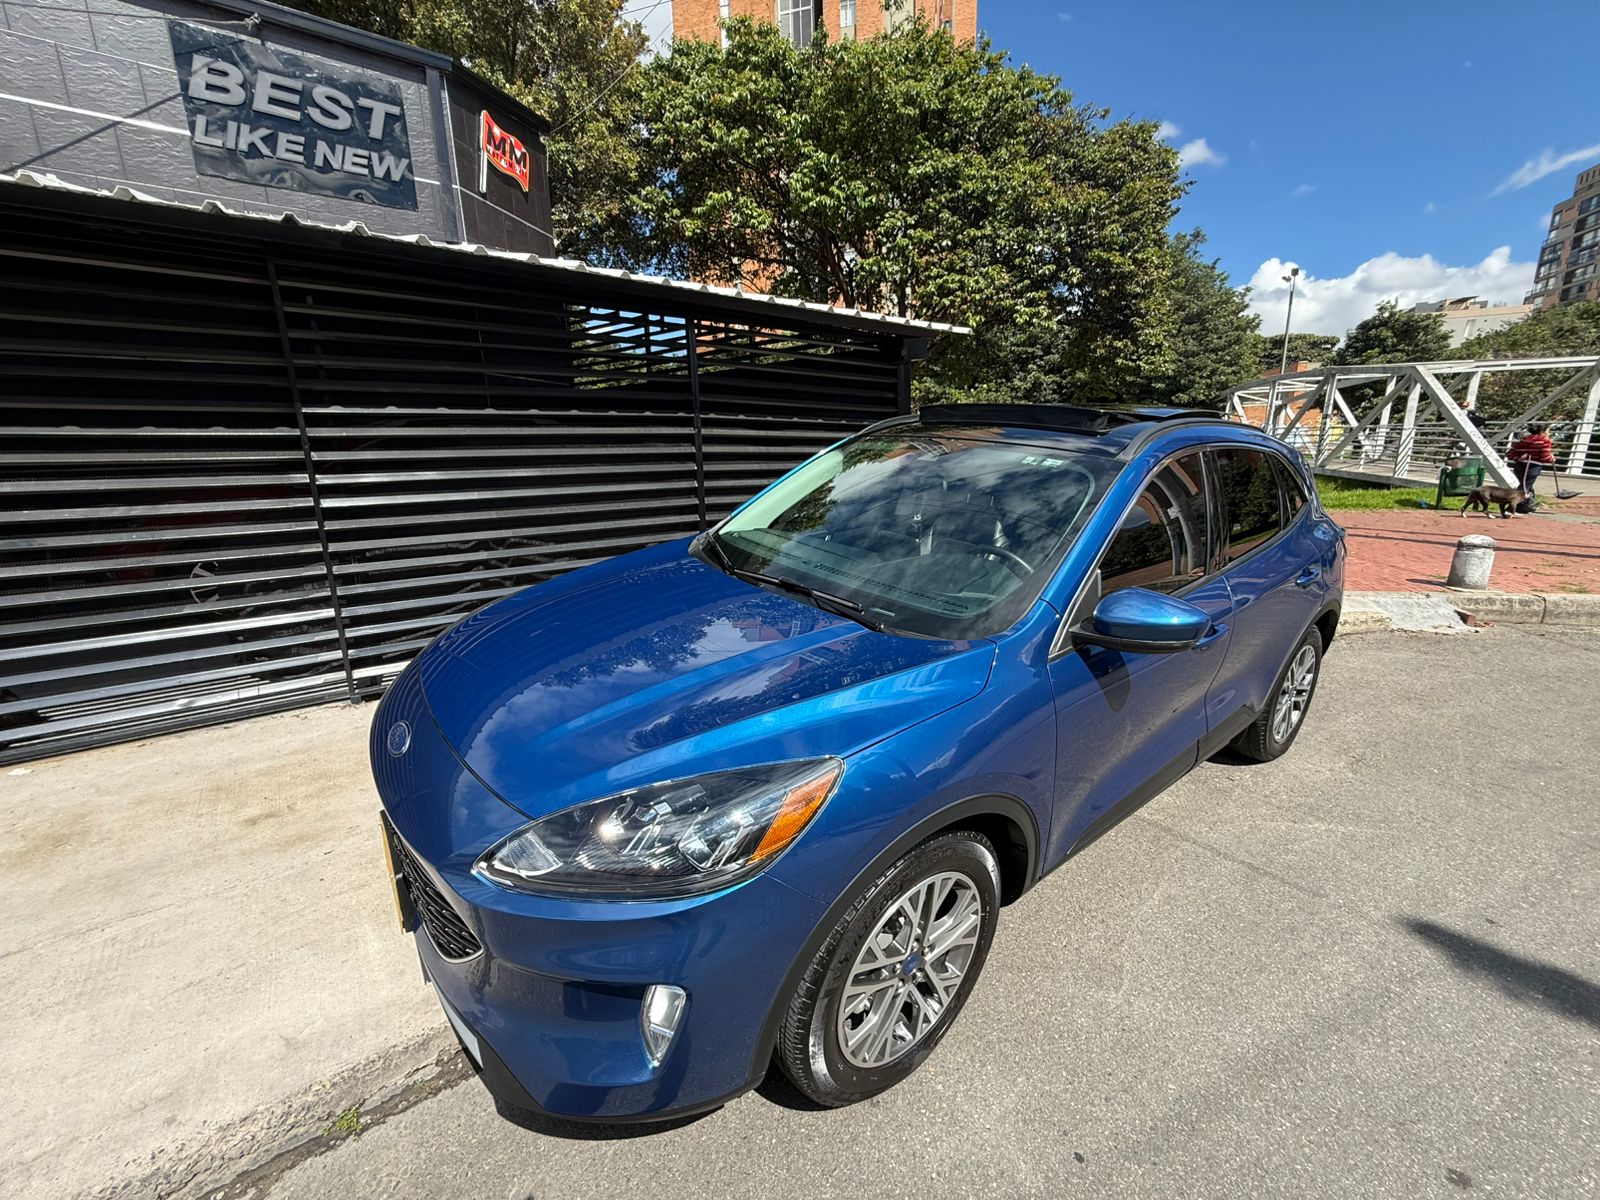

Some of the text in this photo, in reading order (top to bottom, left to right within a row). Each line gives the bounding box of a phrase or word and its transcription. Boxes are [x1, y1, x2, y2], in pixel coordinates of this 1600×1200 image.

[188, 54, 401, 140] BEST
[194, 113, 409, 182] LIKE NEW
[486, 119, 527, 170] MM
